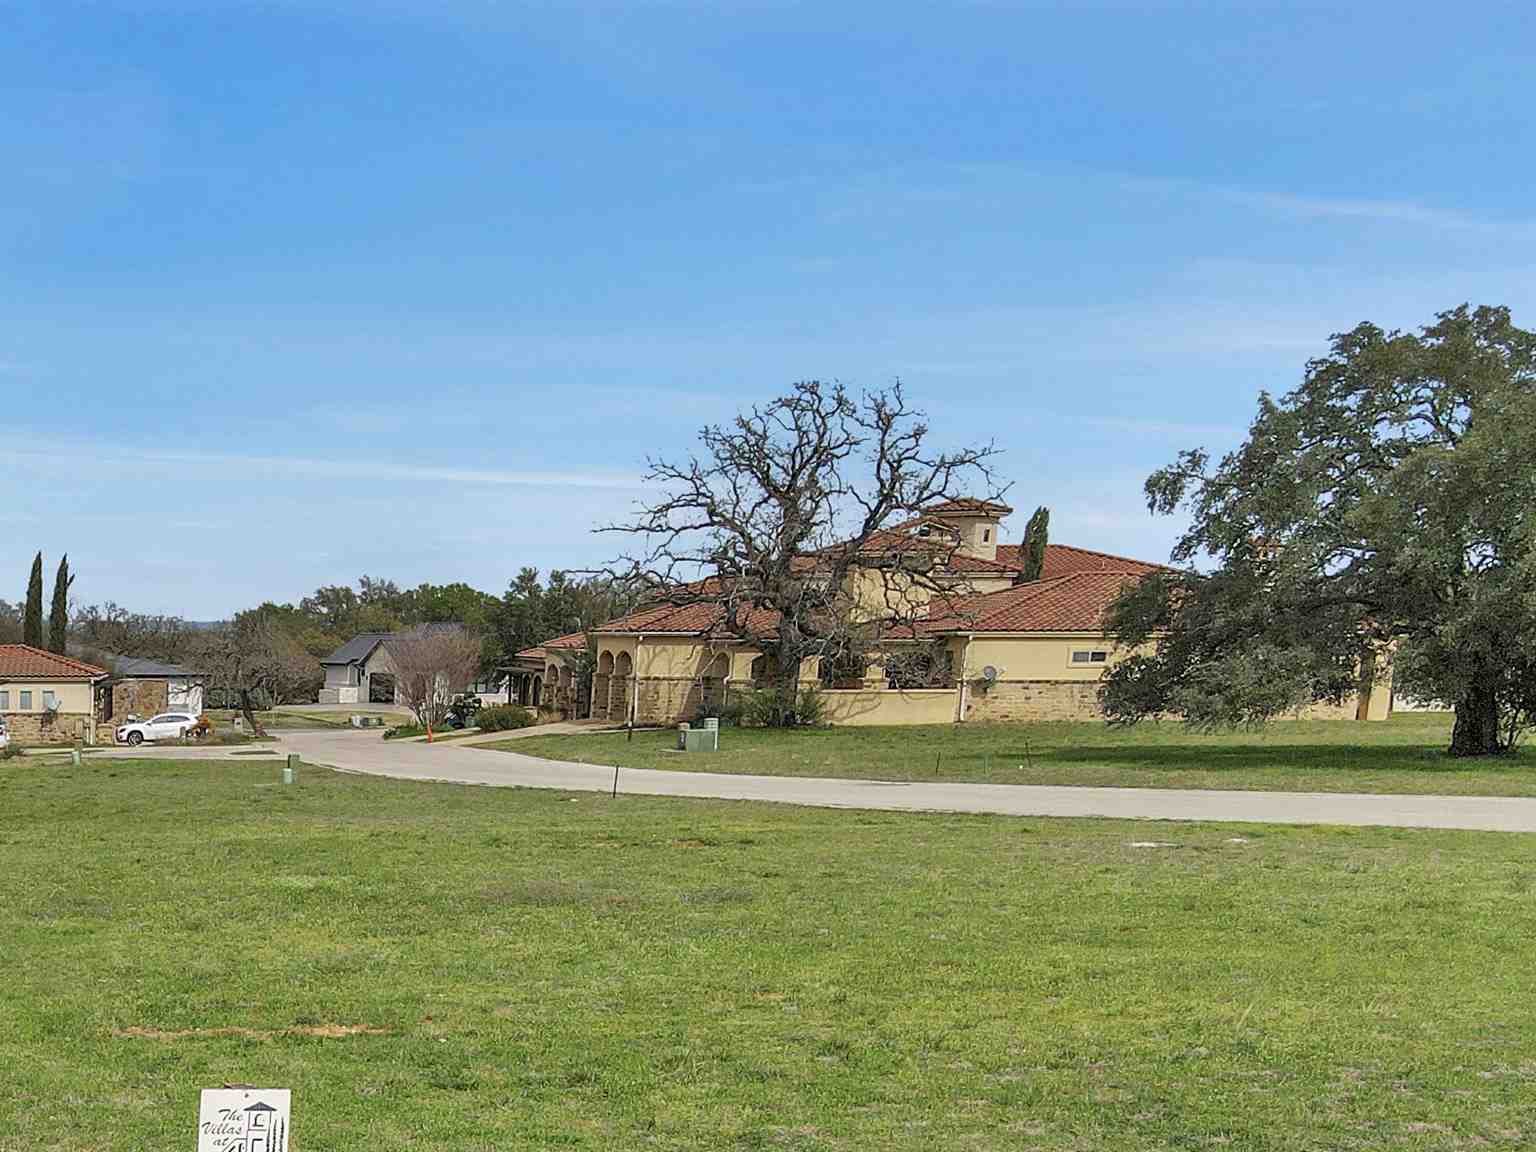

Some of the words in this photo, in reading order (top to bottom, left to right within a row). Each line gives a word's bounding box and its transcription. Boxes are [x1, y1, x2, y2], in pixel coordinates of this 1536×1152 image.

[218, 1108, 243, 1121] The
[201, 1121, 242, 1135] Villas
[213, 1137, 229, 1146] at
